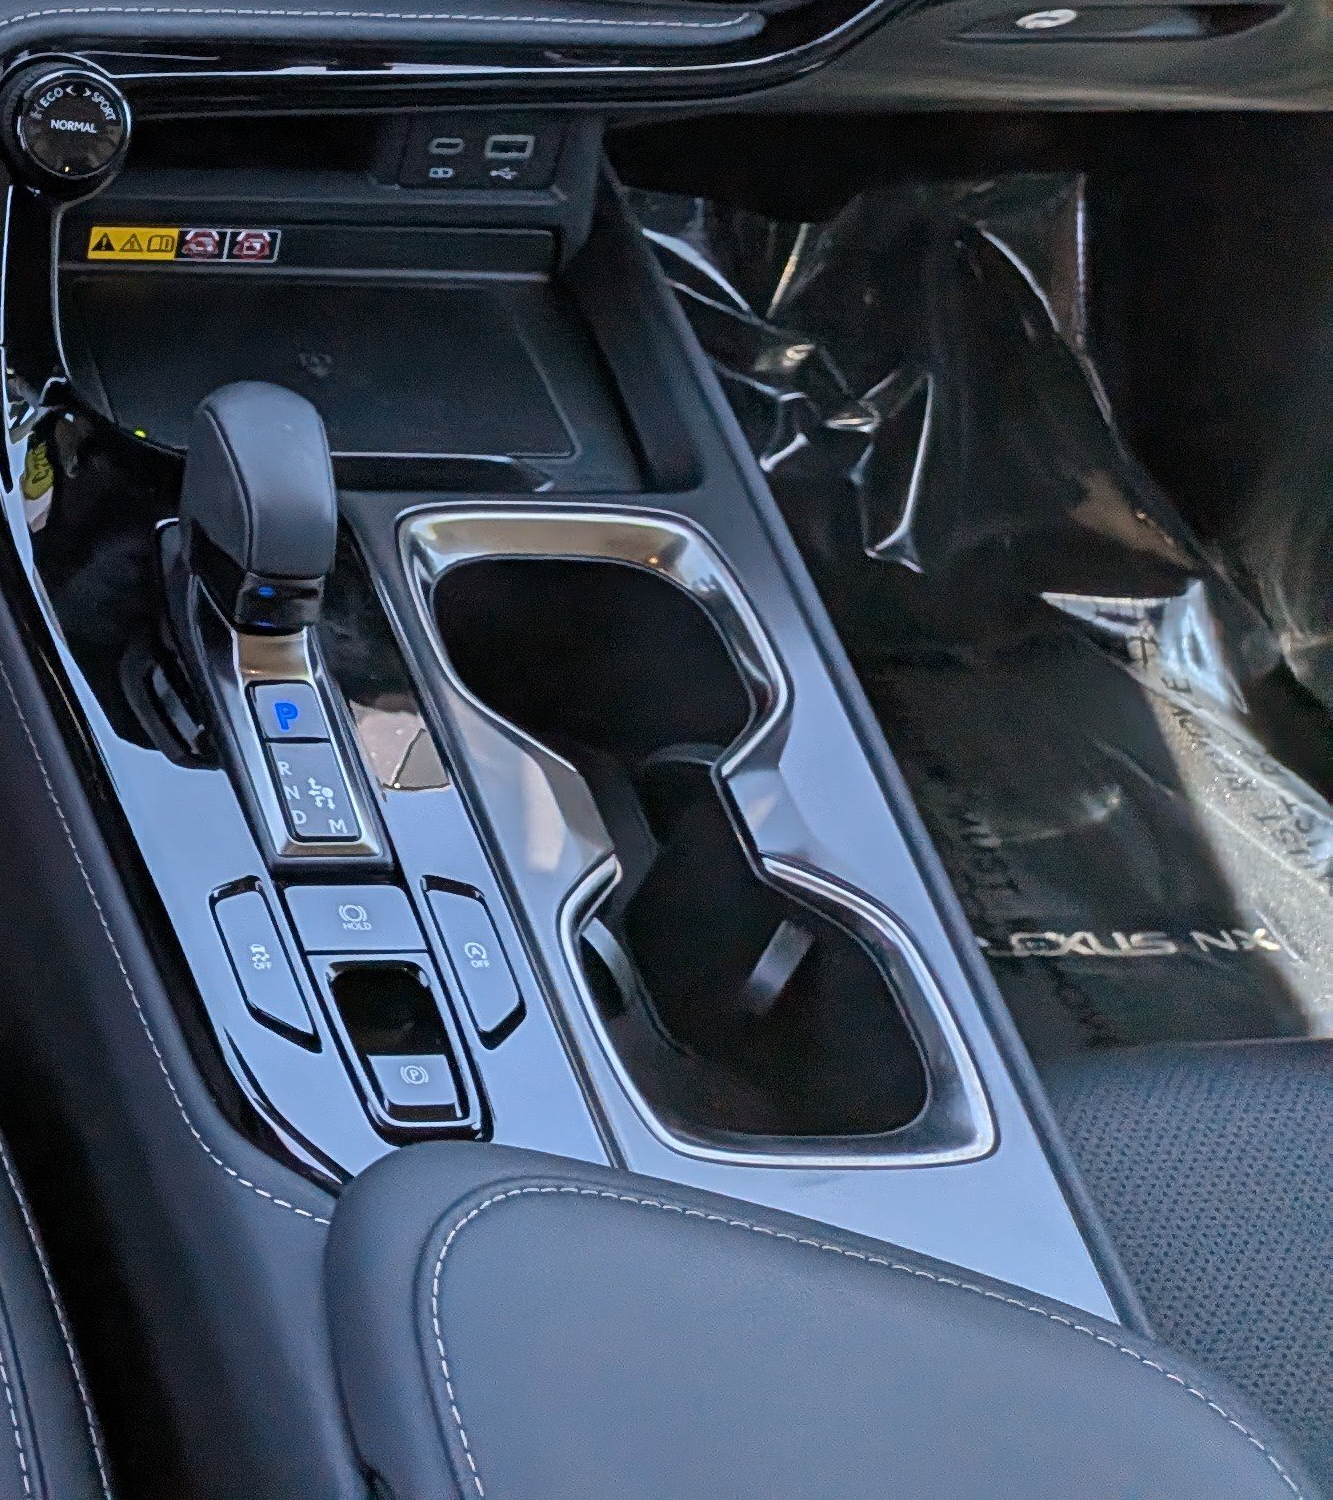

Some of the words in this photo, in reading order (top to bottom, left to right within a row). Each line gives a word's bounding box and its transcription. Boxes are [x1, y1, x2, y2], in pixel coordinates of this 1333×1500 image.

[39, 86, 64, 108] ECO
[91, 91, 117, 121] SPORT
[50, 119, 99, 134] NORMAL
[274, 701, 299, 731] P
[277, 760, 292, 776] R
[284, 785, 301, 800] N
[290, 809, 307, 825] D
[328, 818, 348, 834] M
[342, 921, 372, 931] HOLD
[253, 960, 272, 970] OFF
